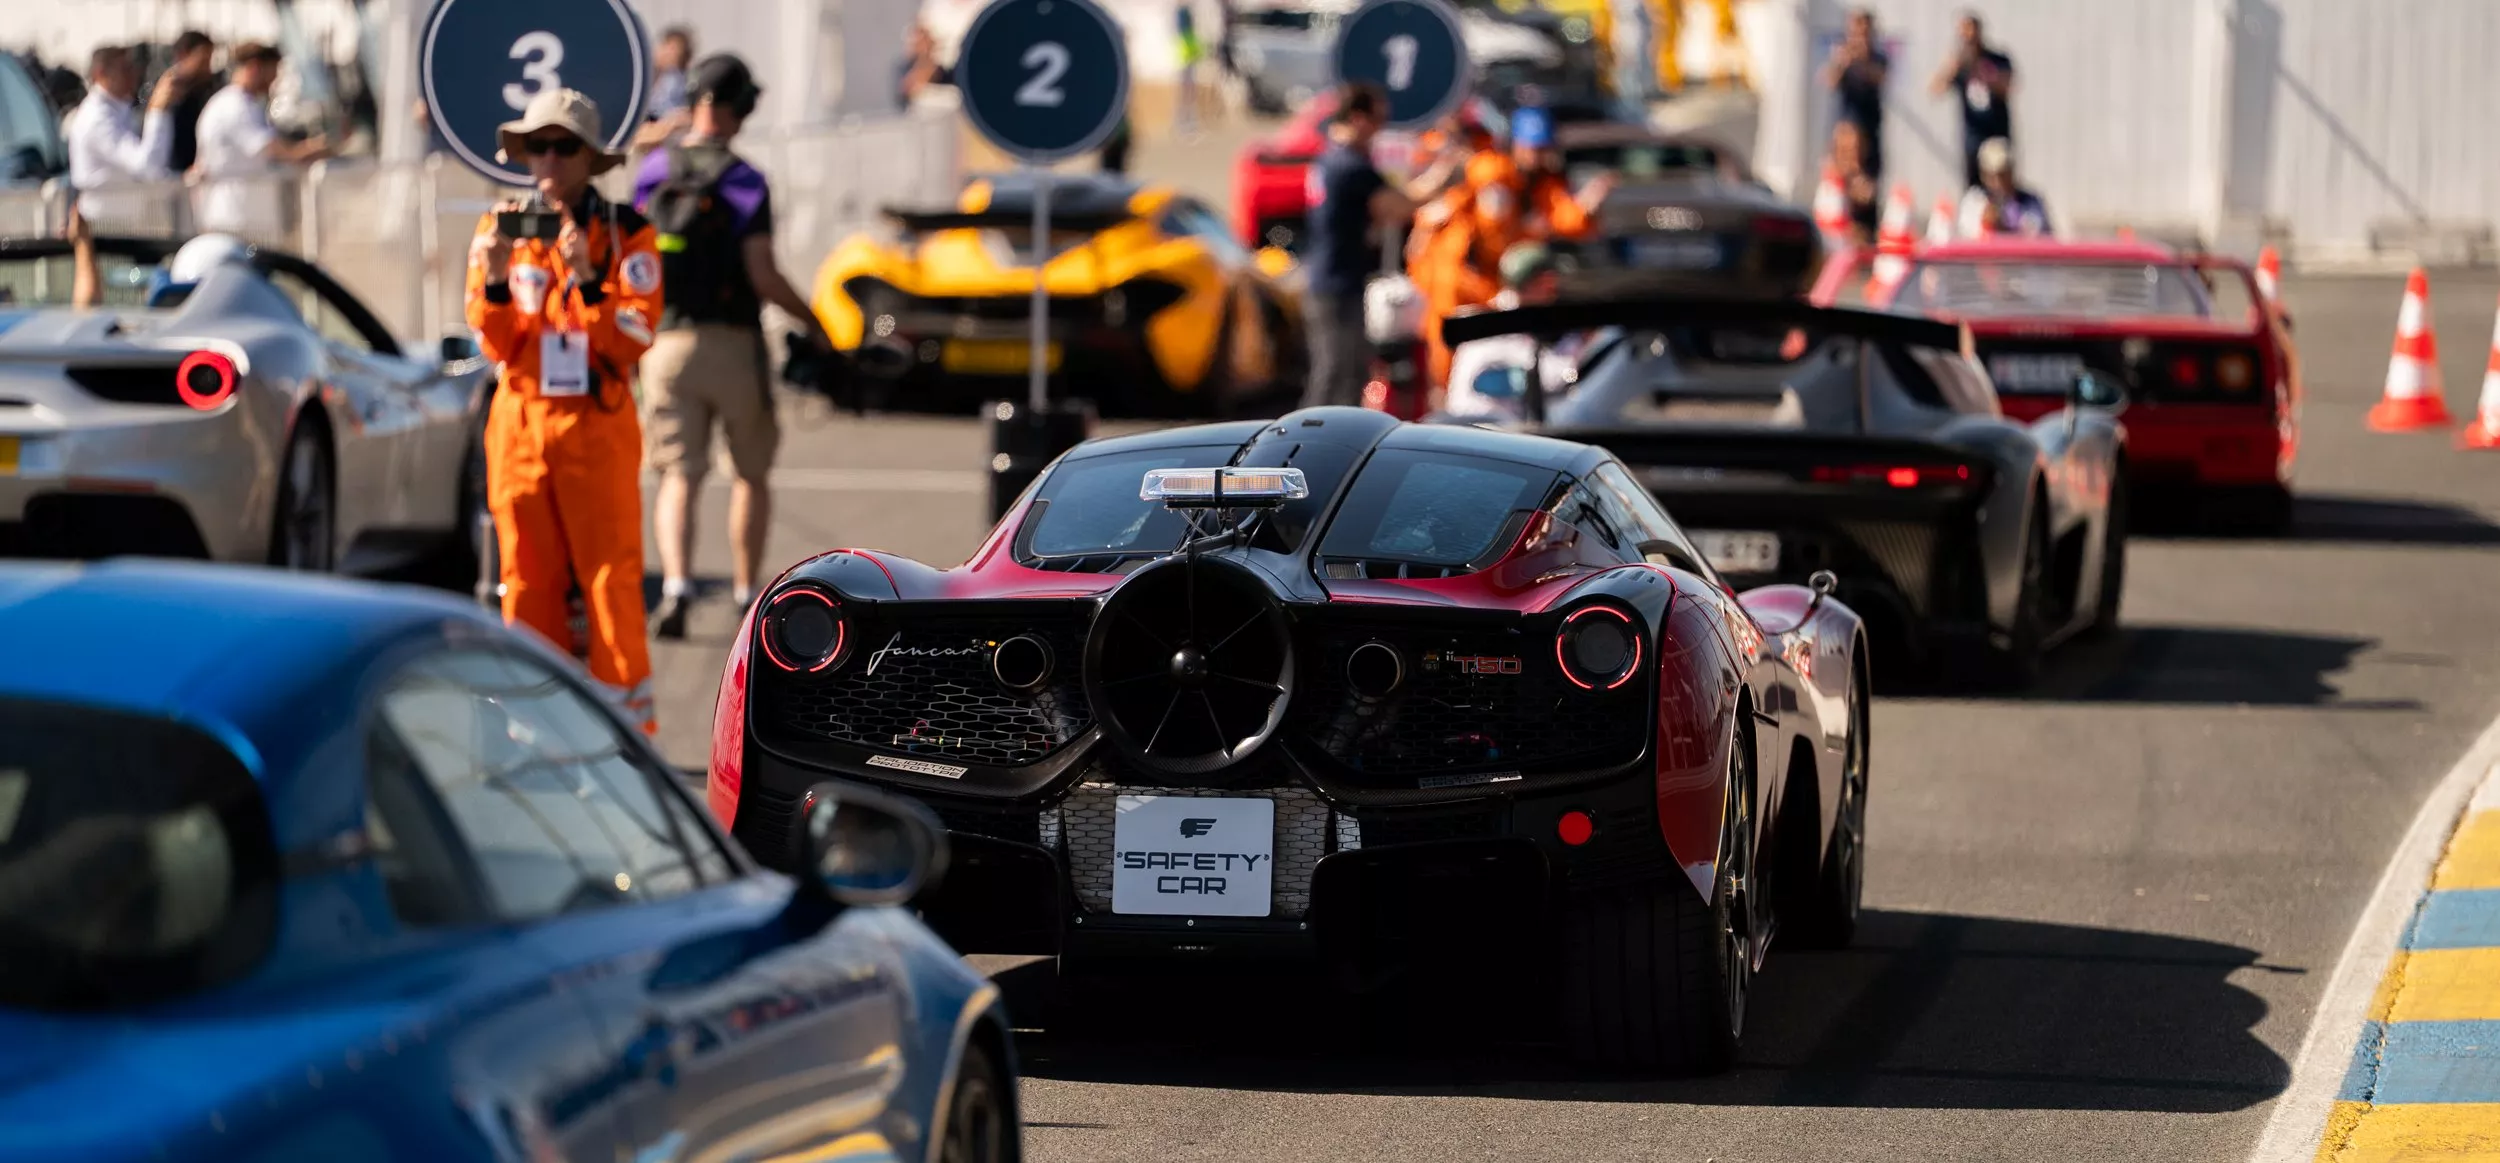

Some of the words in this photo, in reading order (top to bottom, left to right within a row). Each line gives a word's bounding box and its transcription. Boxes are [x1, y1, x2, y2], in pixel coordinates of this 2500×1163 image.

[502, 30, 564, 112] 3
[1381, 34, 1419, 90] 1
[1014, 41, 1070, 107] 2
[1454, 656, 1522, 674] T.50
[869, 759, 960, 777] PROTOTYPE
[876, 756, 965, 773] VALIDATION
[1157, 876, 1227, 895] CAR
